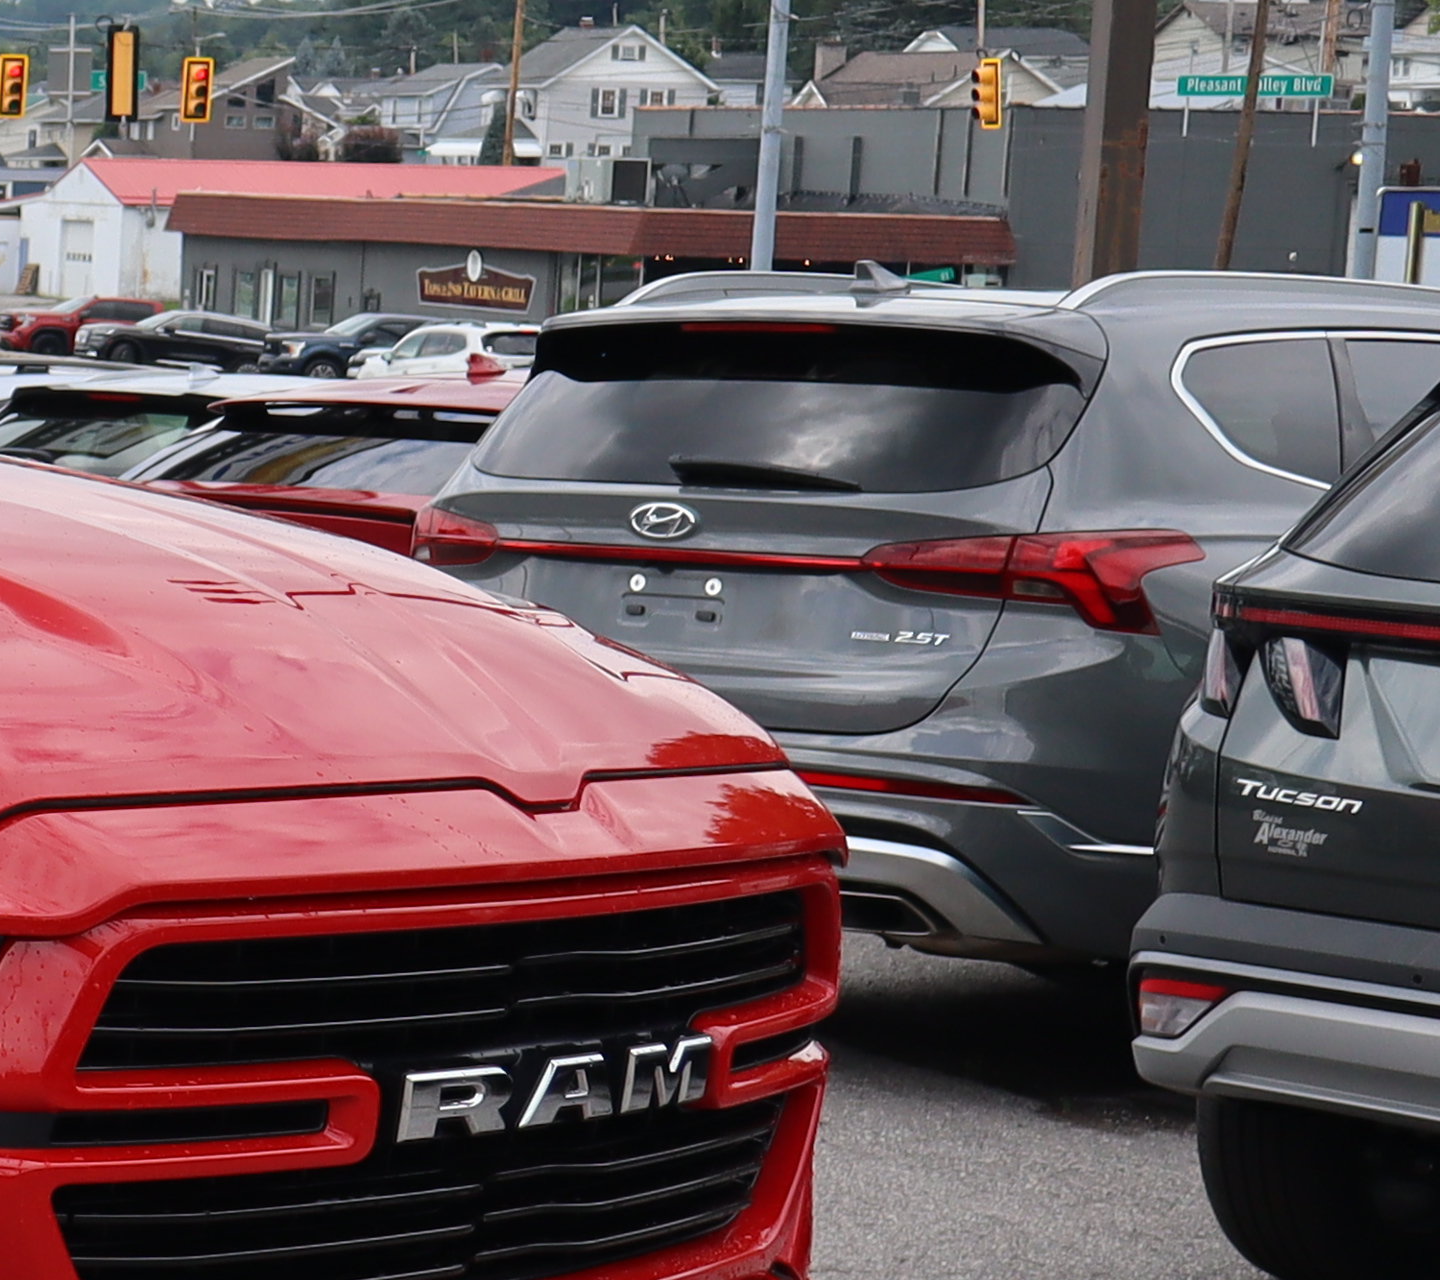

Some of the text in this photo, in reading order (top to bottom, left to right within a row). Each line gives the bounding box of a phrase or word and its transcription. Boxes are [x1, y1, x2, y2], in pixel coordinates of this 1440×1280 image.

[1186, 77, 1322, 95] Pleasant lley Blvd
[1254, 821, 1329, 846] Alexander
[396, 1033, 713, 1143] RAM
